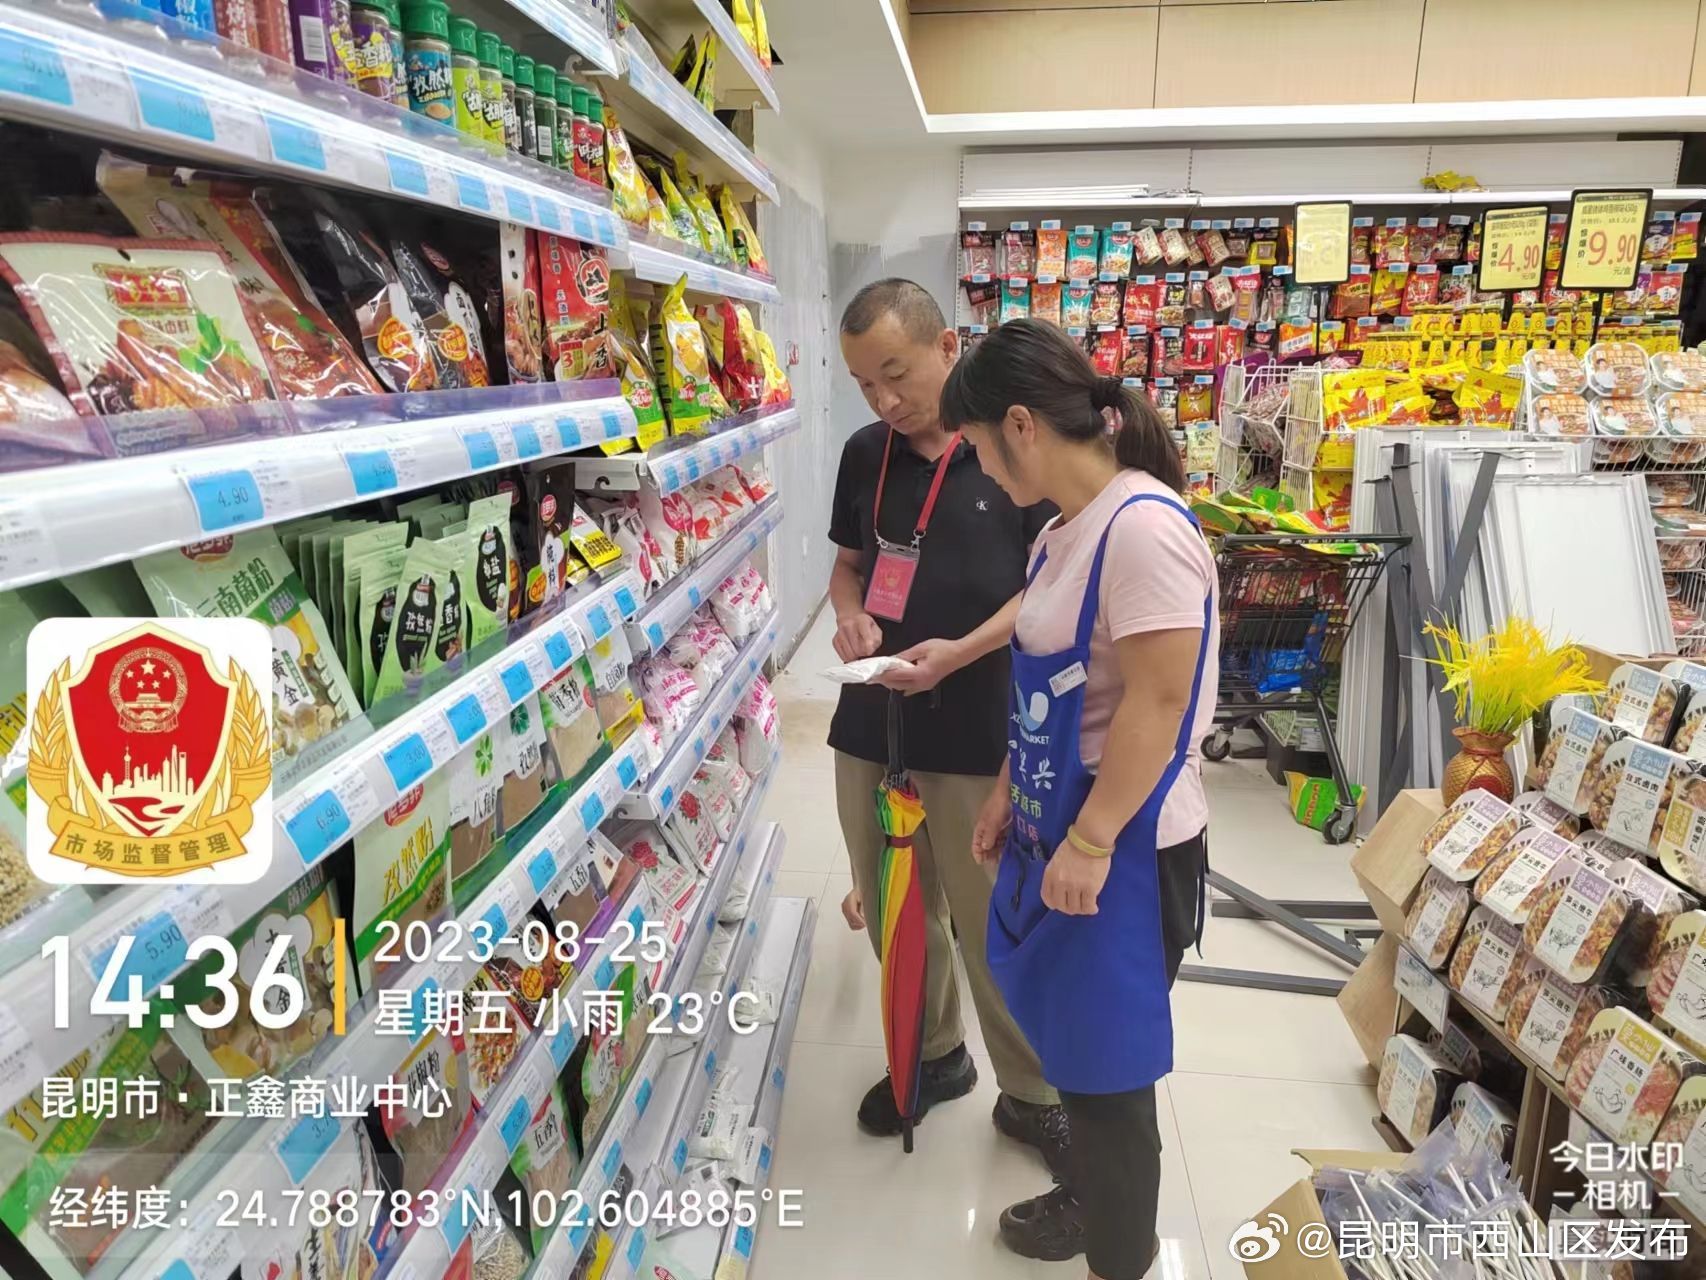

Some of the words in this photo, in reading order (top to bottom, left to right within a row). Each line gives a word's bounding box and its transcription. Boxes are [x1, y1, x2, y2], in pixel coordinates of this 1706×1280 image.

[1498, 243, 1540, 272] 4.90
[1588, 230, 1637, 266] 9.90
[216, 486, 249, 508] 4.90
